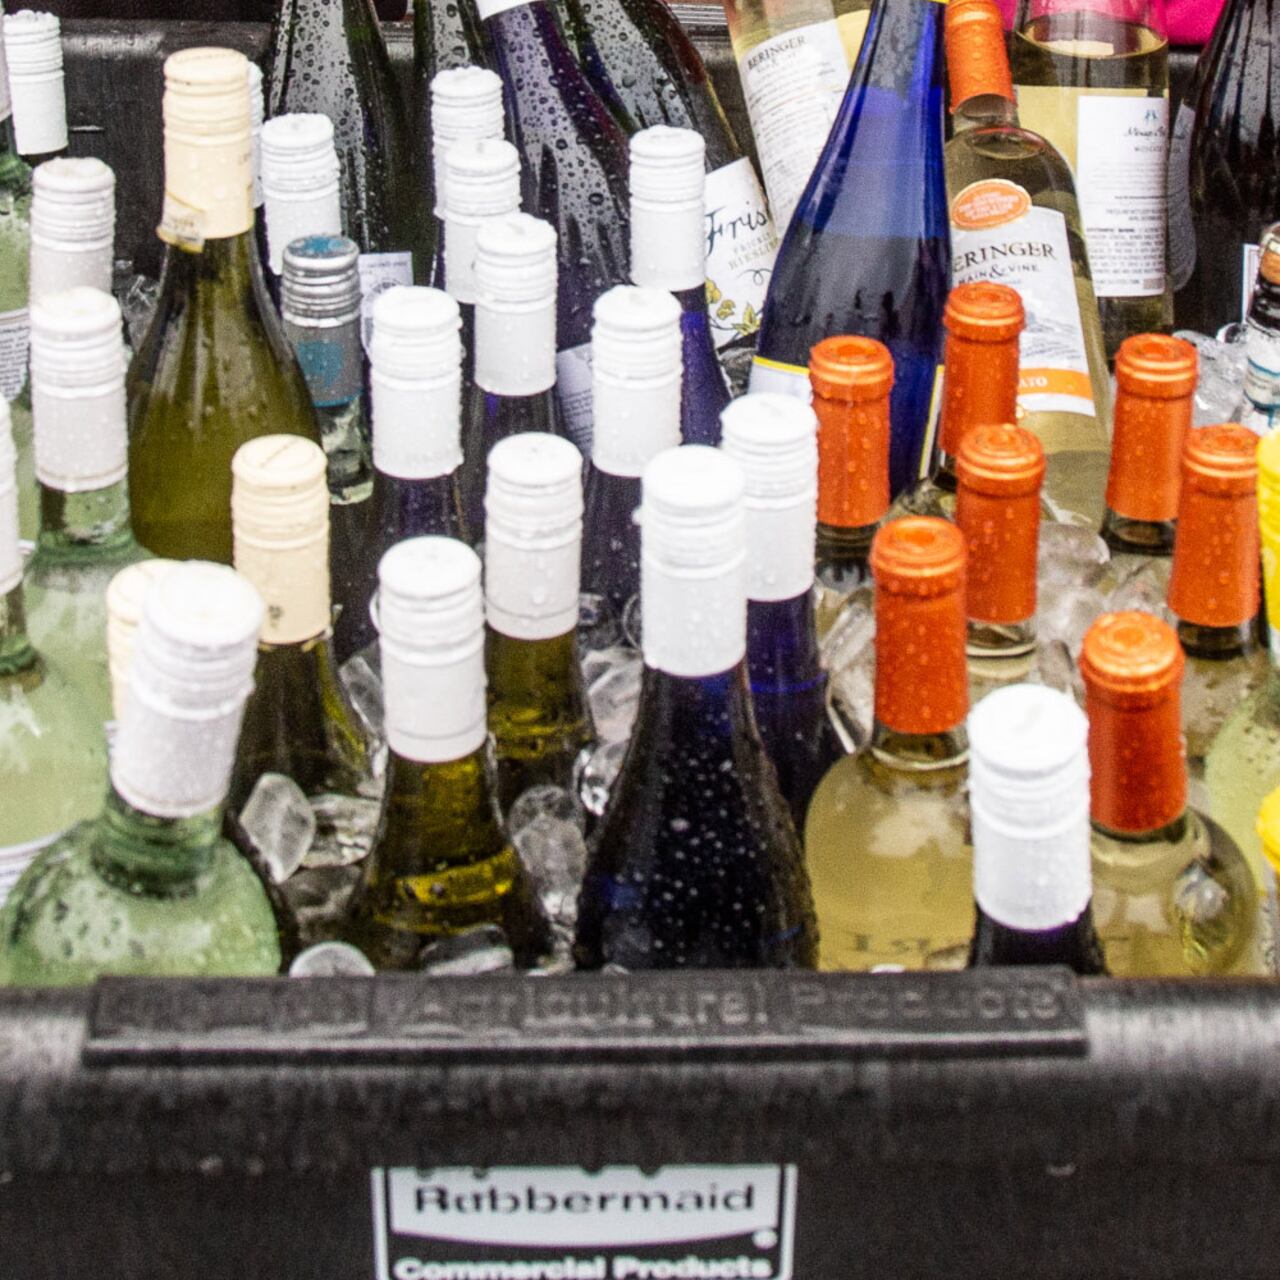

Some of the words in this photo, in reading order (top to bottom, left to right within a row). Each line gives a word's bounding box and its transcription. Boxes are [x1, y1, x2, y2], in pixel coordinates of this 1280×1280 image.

[415, 1183, 754, 1215] Rubbermaid
[393, 1256, 606, 1280] Commercial
[613, 1255, 772, 1279] Products
